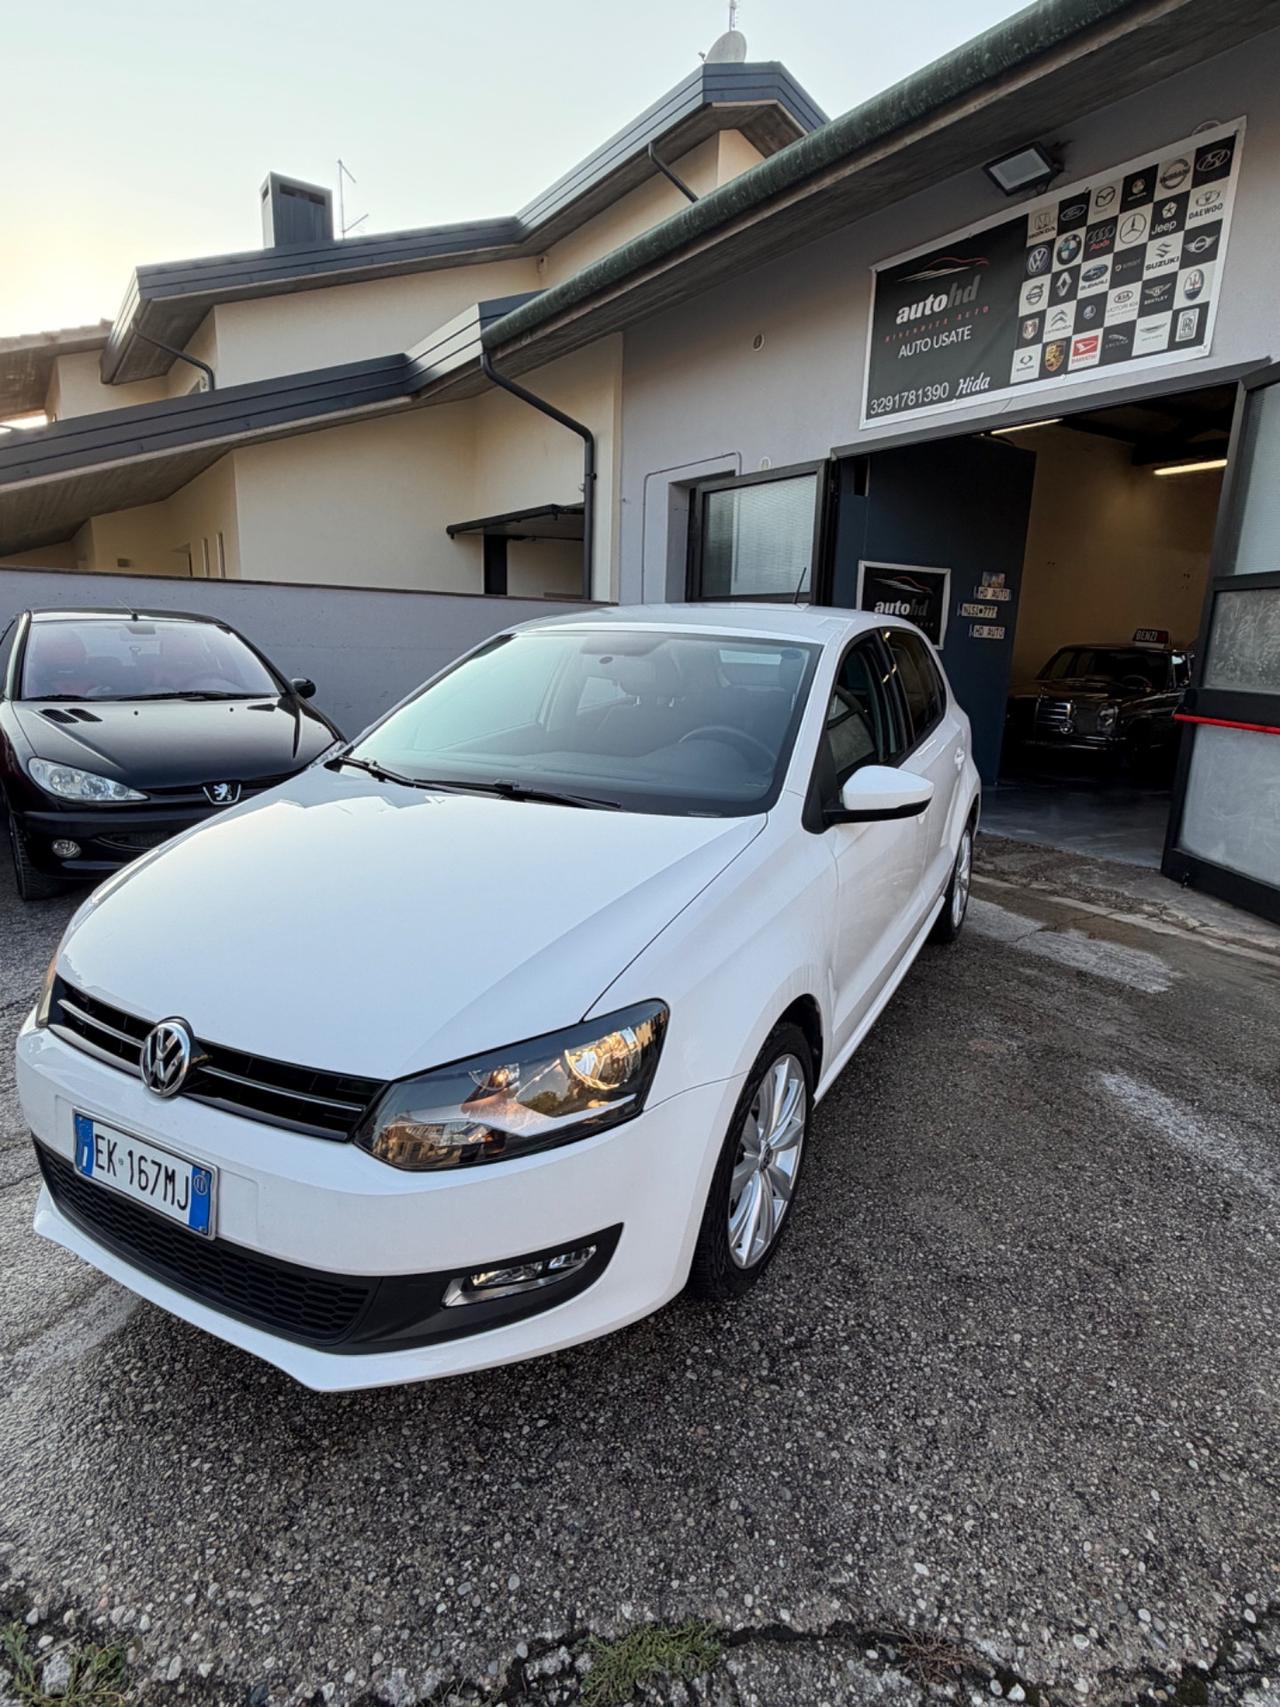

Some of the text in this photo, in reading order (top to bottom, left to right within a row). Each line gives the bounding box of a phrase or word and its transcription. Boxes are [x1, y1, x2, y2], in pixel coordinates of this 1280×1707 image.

[1189, 203, 1223, 219] DAEWOO
[1152, 220, 1177, 235] Jeep
[1145, 255, 1180, 271] SUZUKI
[895, 273, 982, 325] autohd
[898, 324, 973, 359] AUTO USATE
[870, 371, 991, 415] 3291781390 Hida
[874, 599, 928, 617] autohd
